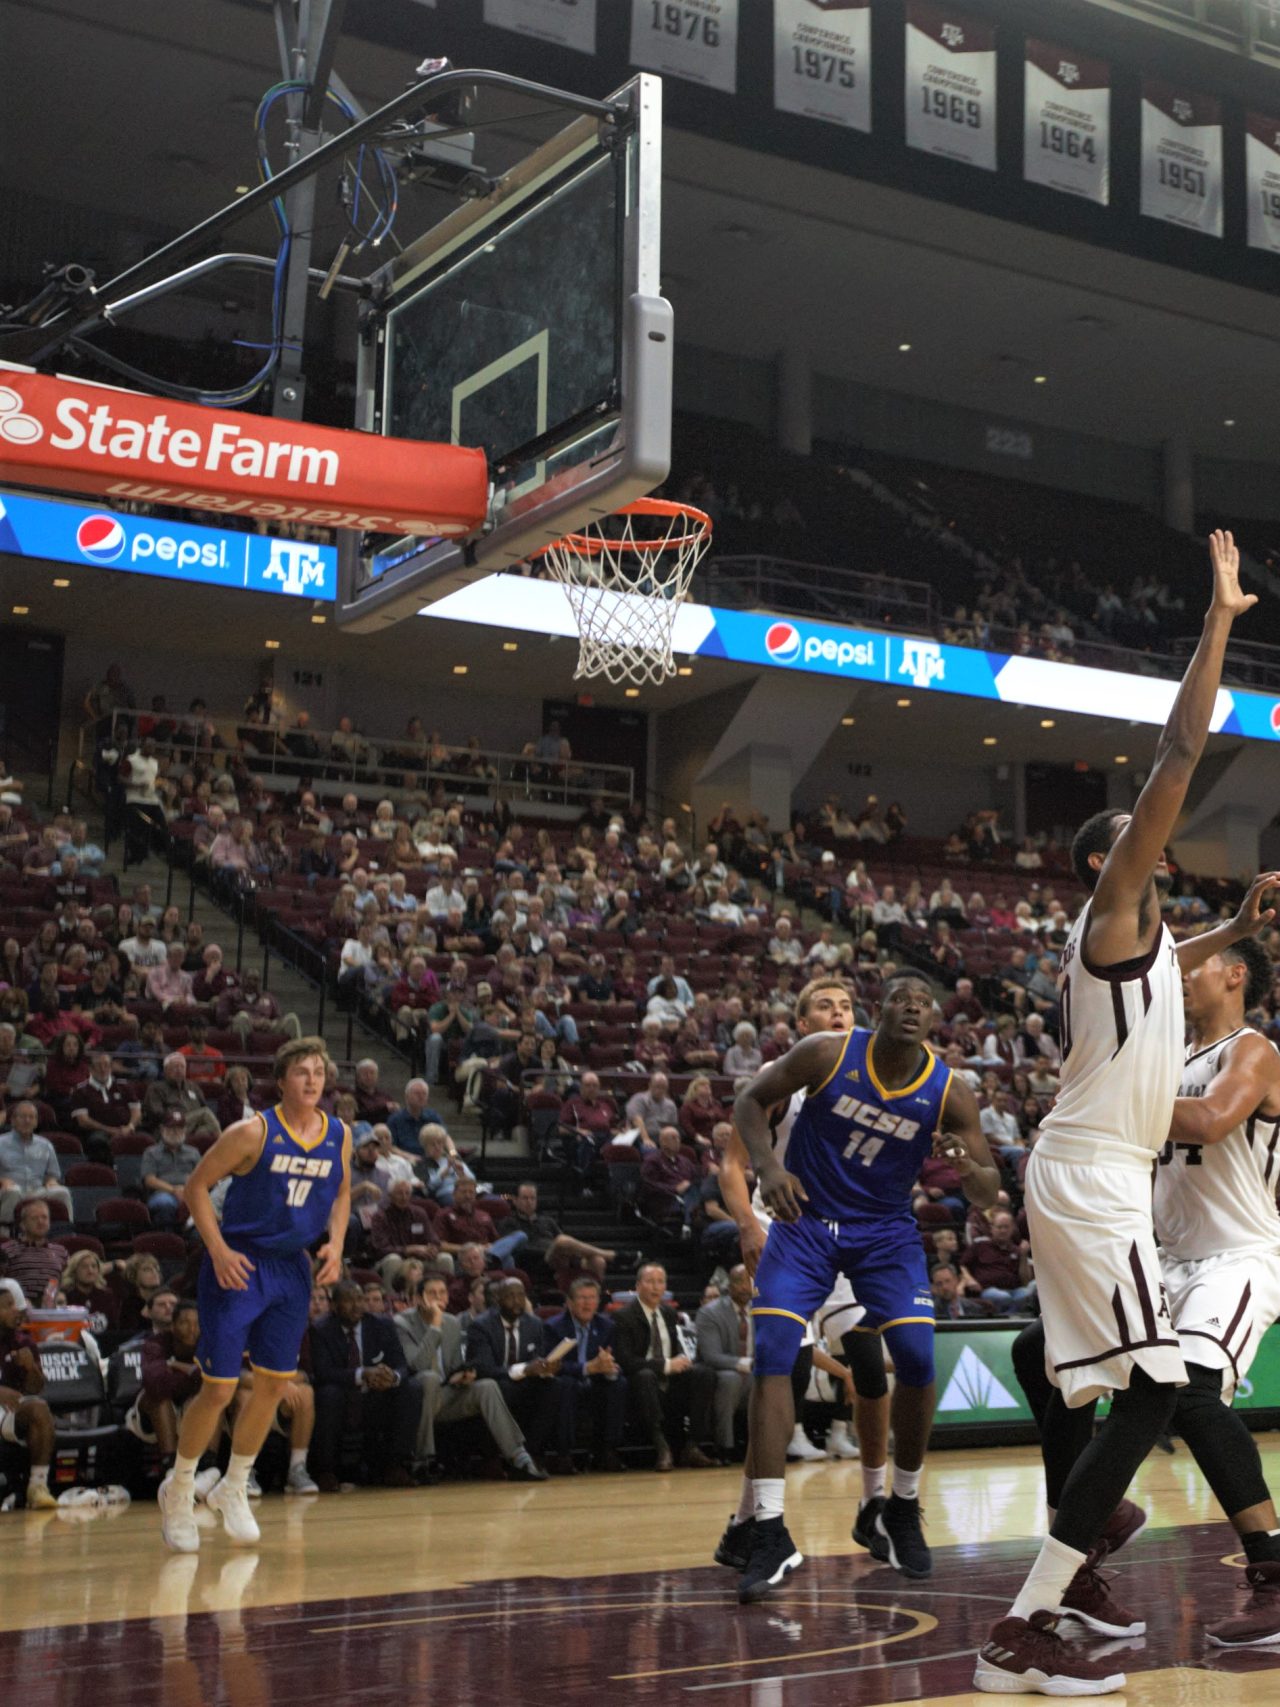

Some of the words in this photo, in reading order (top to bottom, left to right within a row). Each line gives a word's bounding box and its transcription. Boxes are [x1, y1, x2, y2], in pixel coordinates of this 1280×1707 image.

[651, 2, 720, 47] 1976
[792, 46, 856, 88] 1975
[922, 86, 982, 129] 1969
[1040, 121, 1097, 164] 1964
[1158, 158, 1206, 198] 1951
[131, 534, 229, 569] pepsi
[804, 636, 874, 667] pepsi
[831, 1094, 921, 1142] UCSB
[842, 1129, 886, 1168] 14
[286, 1178, 314, 1208] 10
